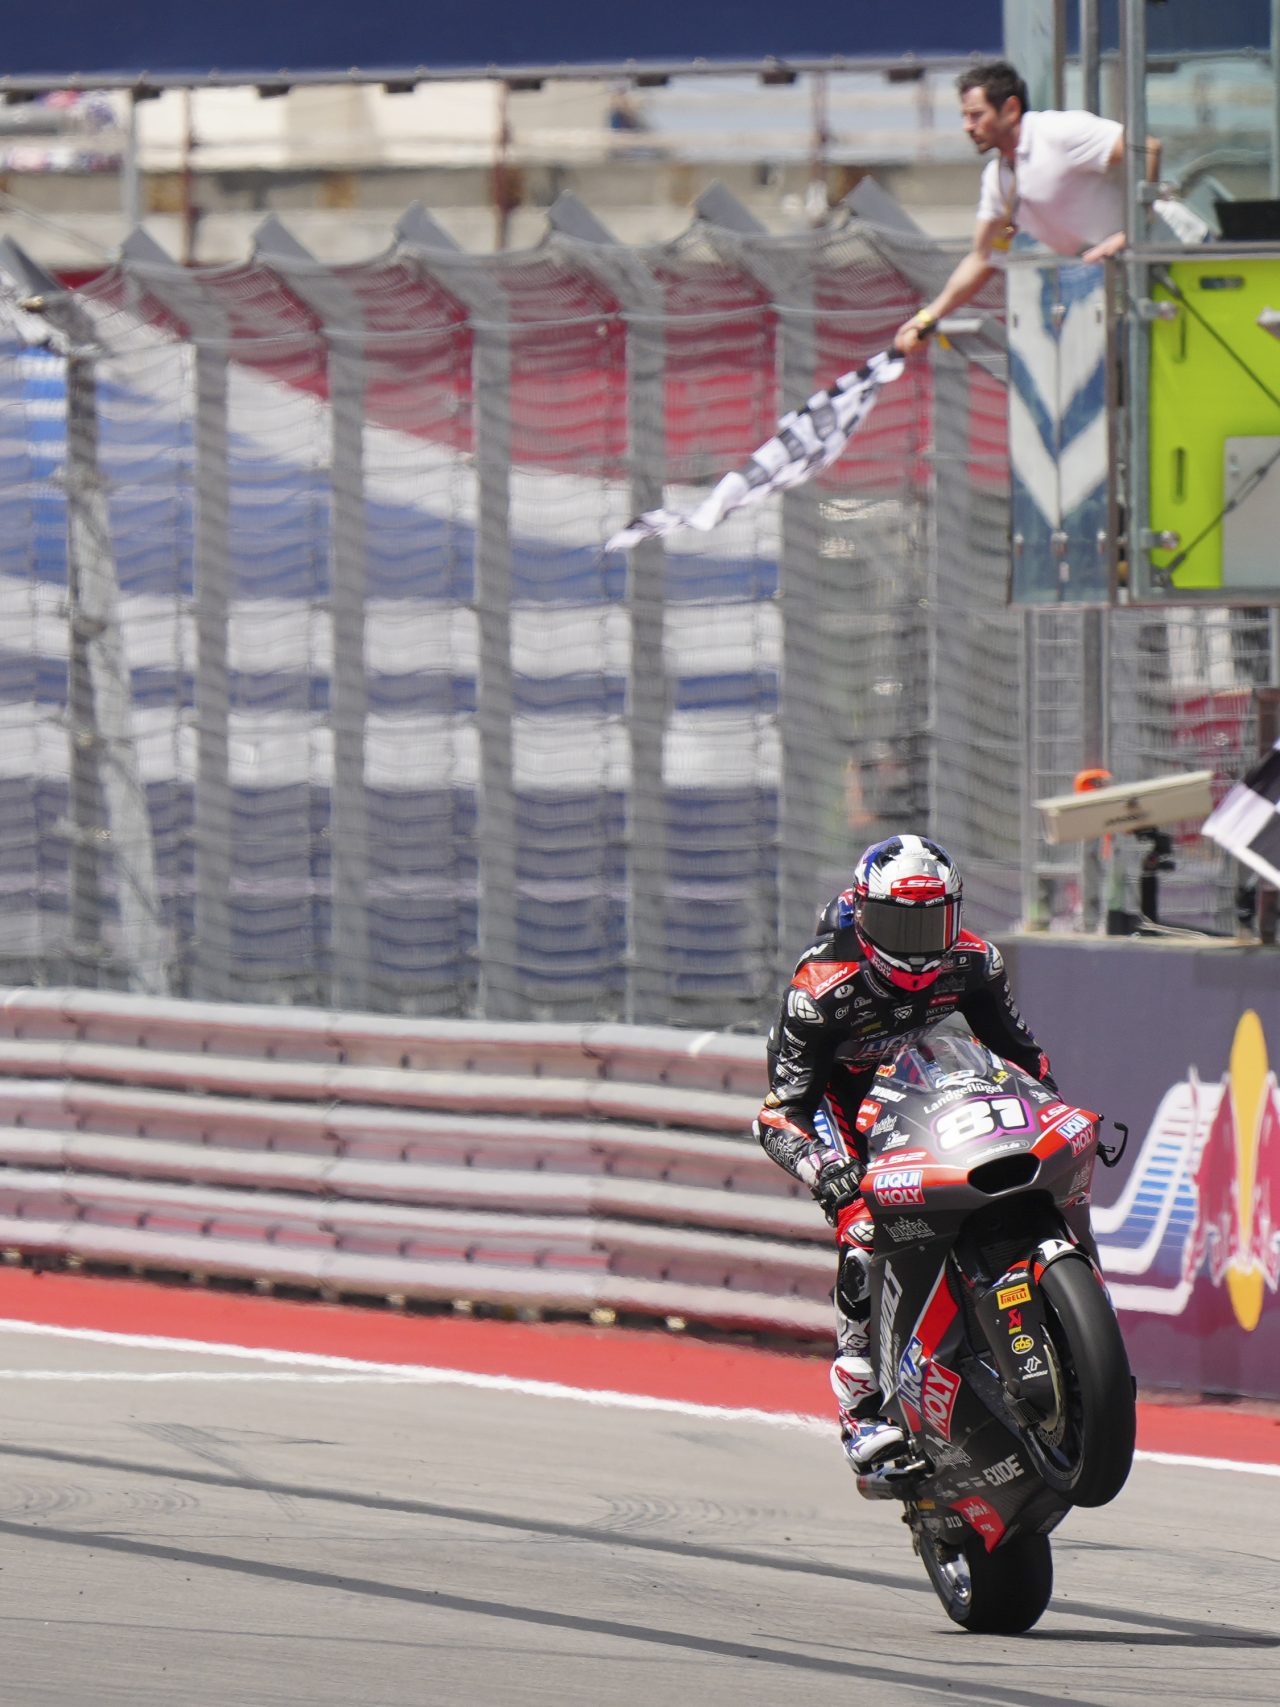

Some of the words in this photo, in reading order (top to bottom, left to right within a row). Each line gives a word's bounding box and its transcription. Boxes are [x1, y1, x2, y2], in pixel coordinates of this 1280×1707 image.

[891, 879, 944, 888] LS2
[815, 966, 848, 993] IXON
[923, 1083, 1004, 1114] Landgeflügel
[936, 1098, 1026, 1150] 81
[1041, 1104, 1070, 1123] LS2
[1060, 1114, 1091, 1140] LIQUI
[1072, 1126, 1094, 1155] MOLY
[876, 1171, 921, 1189] LIQUI
[877, 1188, 921, 1204] MOLY
[1000, 1287, 1028, 1305] PIRELLI
[924, 1363, 956, 1432] MOLY
[982, 1453, 1025, 1487] EXIDE
